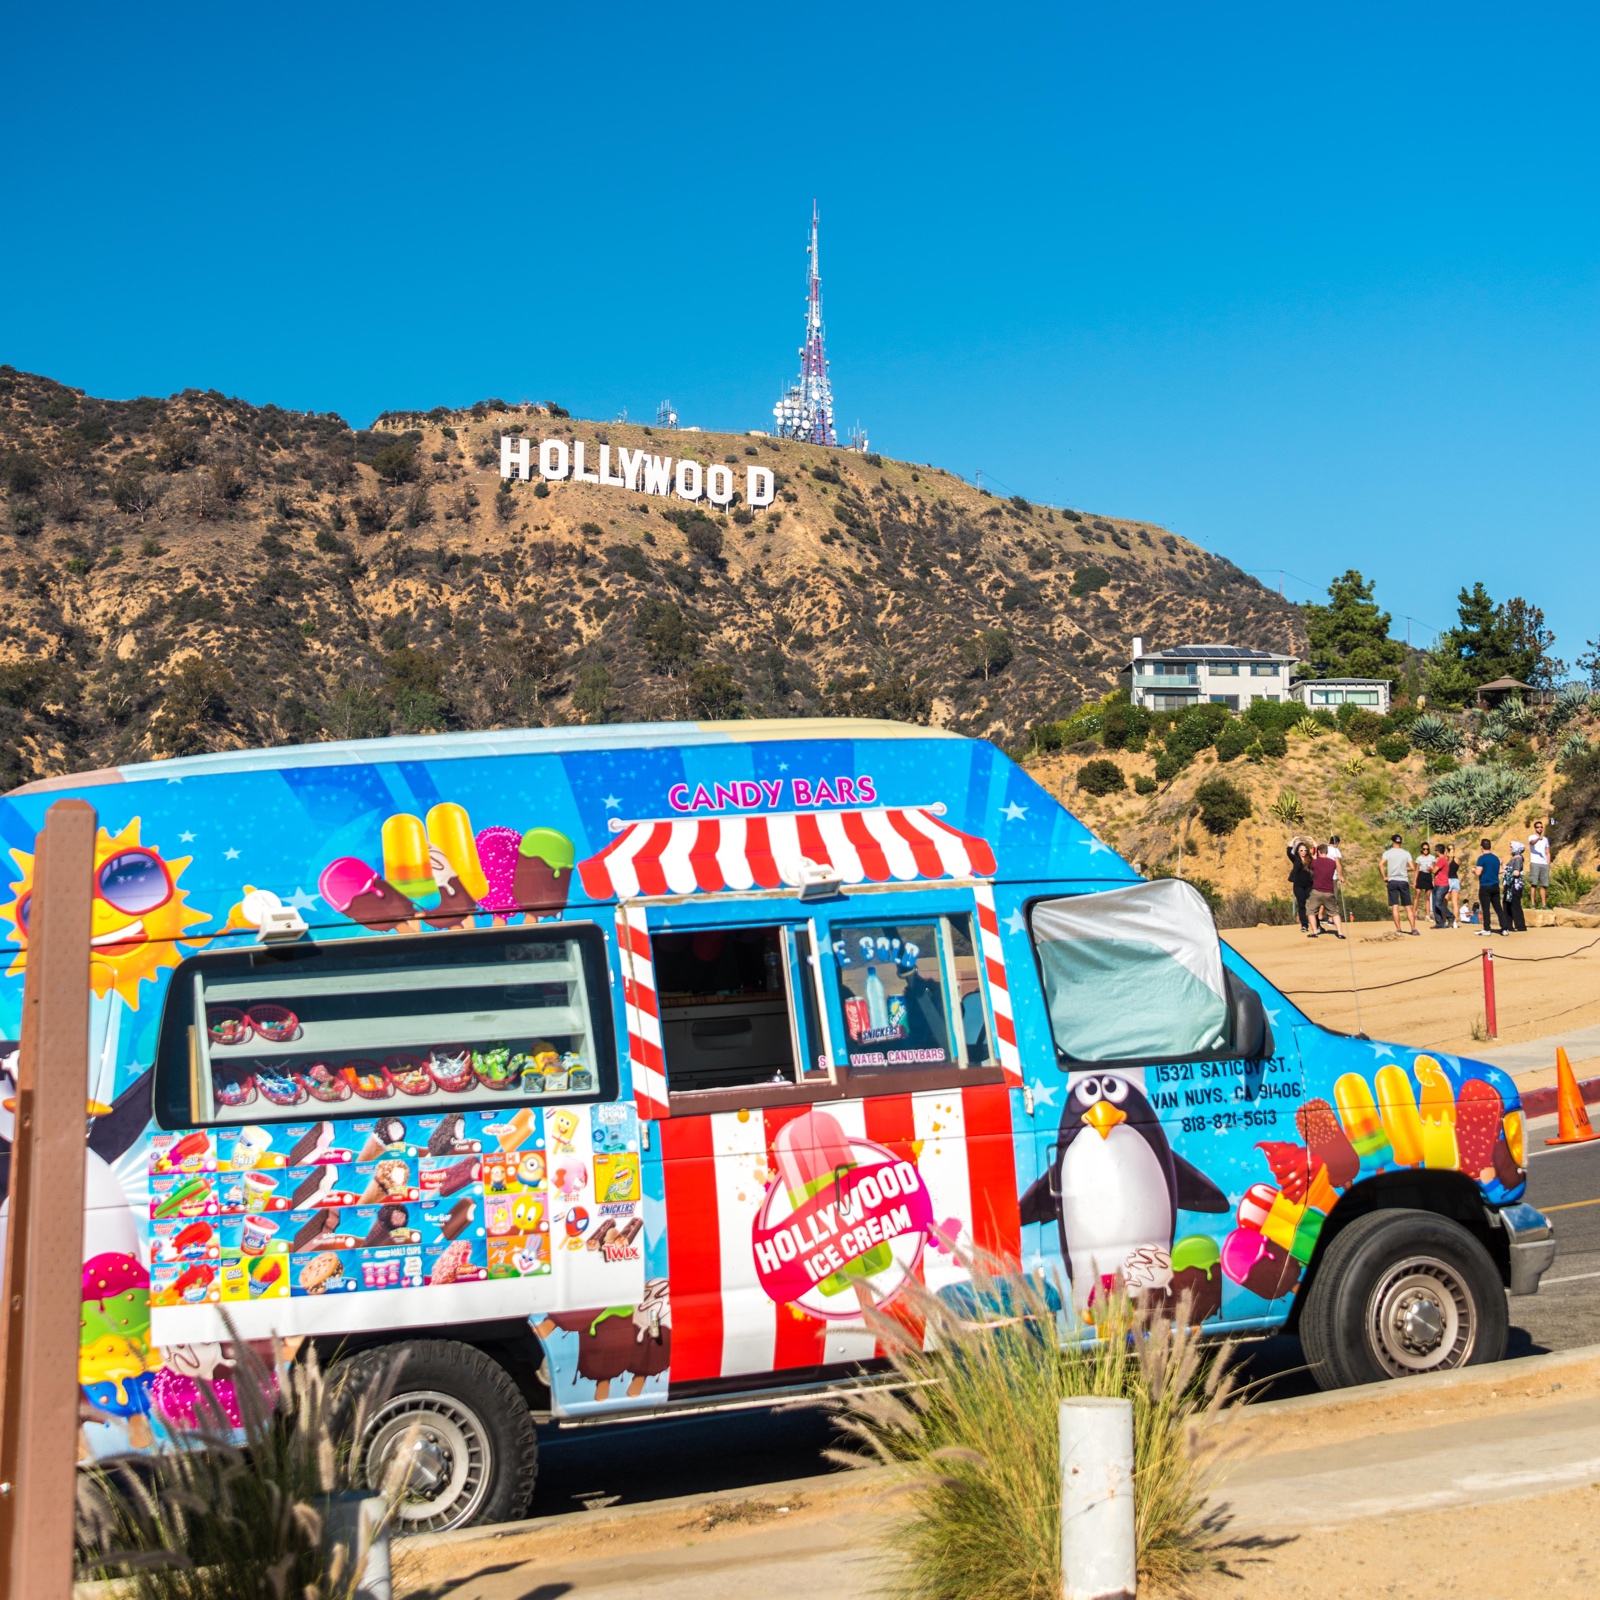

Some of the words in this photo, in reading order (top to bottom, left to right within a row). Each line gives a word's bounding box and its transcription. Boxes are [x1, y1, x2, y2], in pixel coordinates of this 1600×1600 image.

[500, 436, 774, 506] HOLLYWOOD
[668, 779, 783, 811] CANDY
[792, 775, 877, 806] BARS
[859, 936, 919, 968] COLD
[862, 1025, 899, 1040] SNICKERS
[850, 1052, 888, 1067] WATER,
[887, 1048, 945, 1063] CANDYBARS
[1155, 1064, 1194, 1082] 15321
[1200, 1060, 1263, 1078] SATICOY
[1266, 1057, 1291, 1073] ST.
[1151, 1092, 1178, 1109] VAN
[1185, 1087, 1228, 1107] NUYS,
[1234, 1085, 1254, 1101] CA
[1258, 1082, 1301, 1100] 91406
[1182, 1109, 1277, 1133] 818-821-5613
[600, 1203, 635, 1214] SNICKERS
[754, 1161, 920, 1275] HOLLYWOOD
[803, 1244, 845, 1283] ICE
[839, 1204, 913, 1258] CREAM
